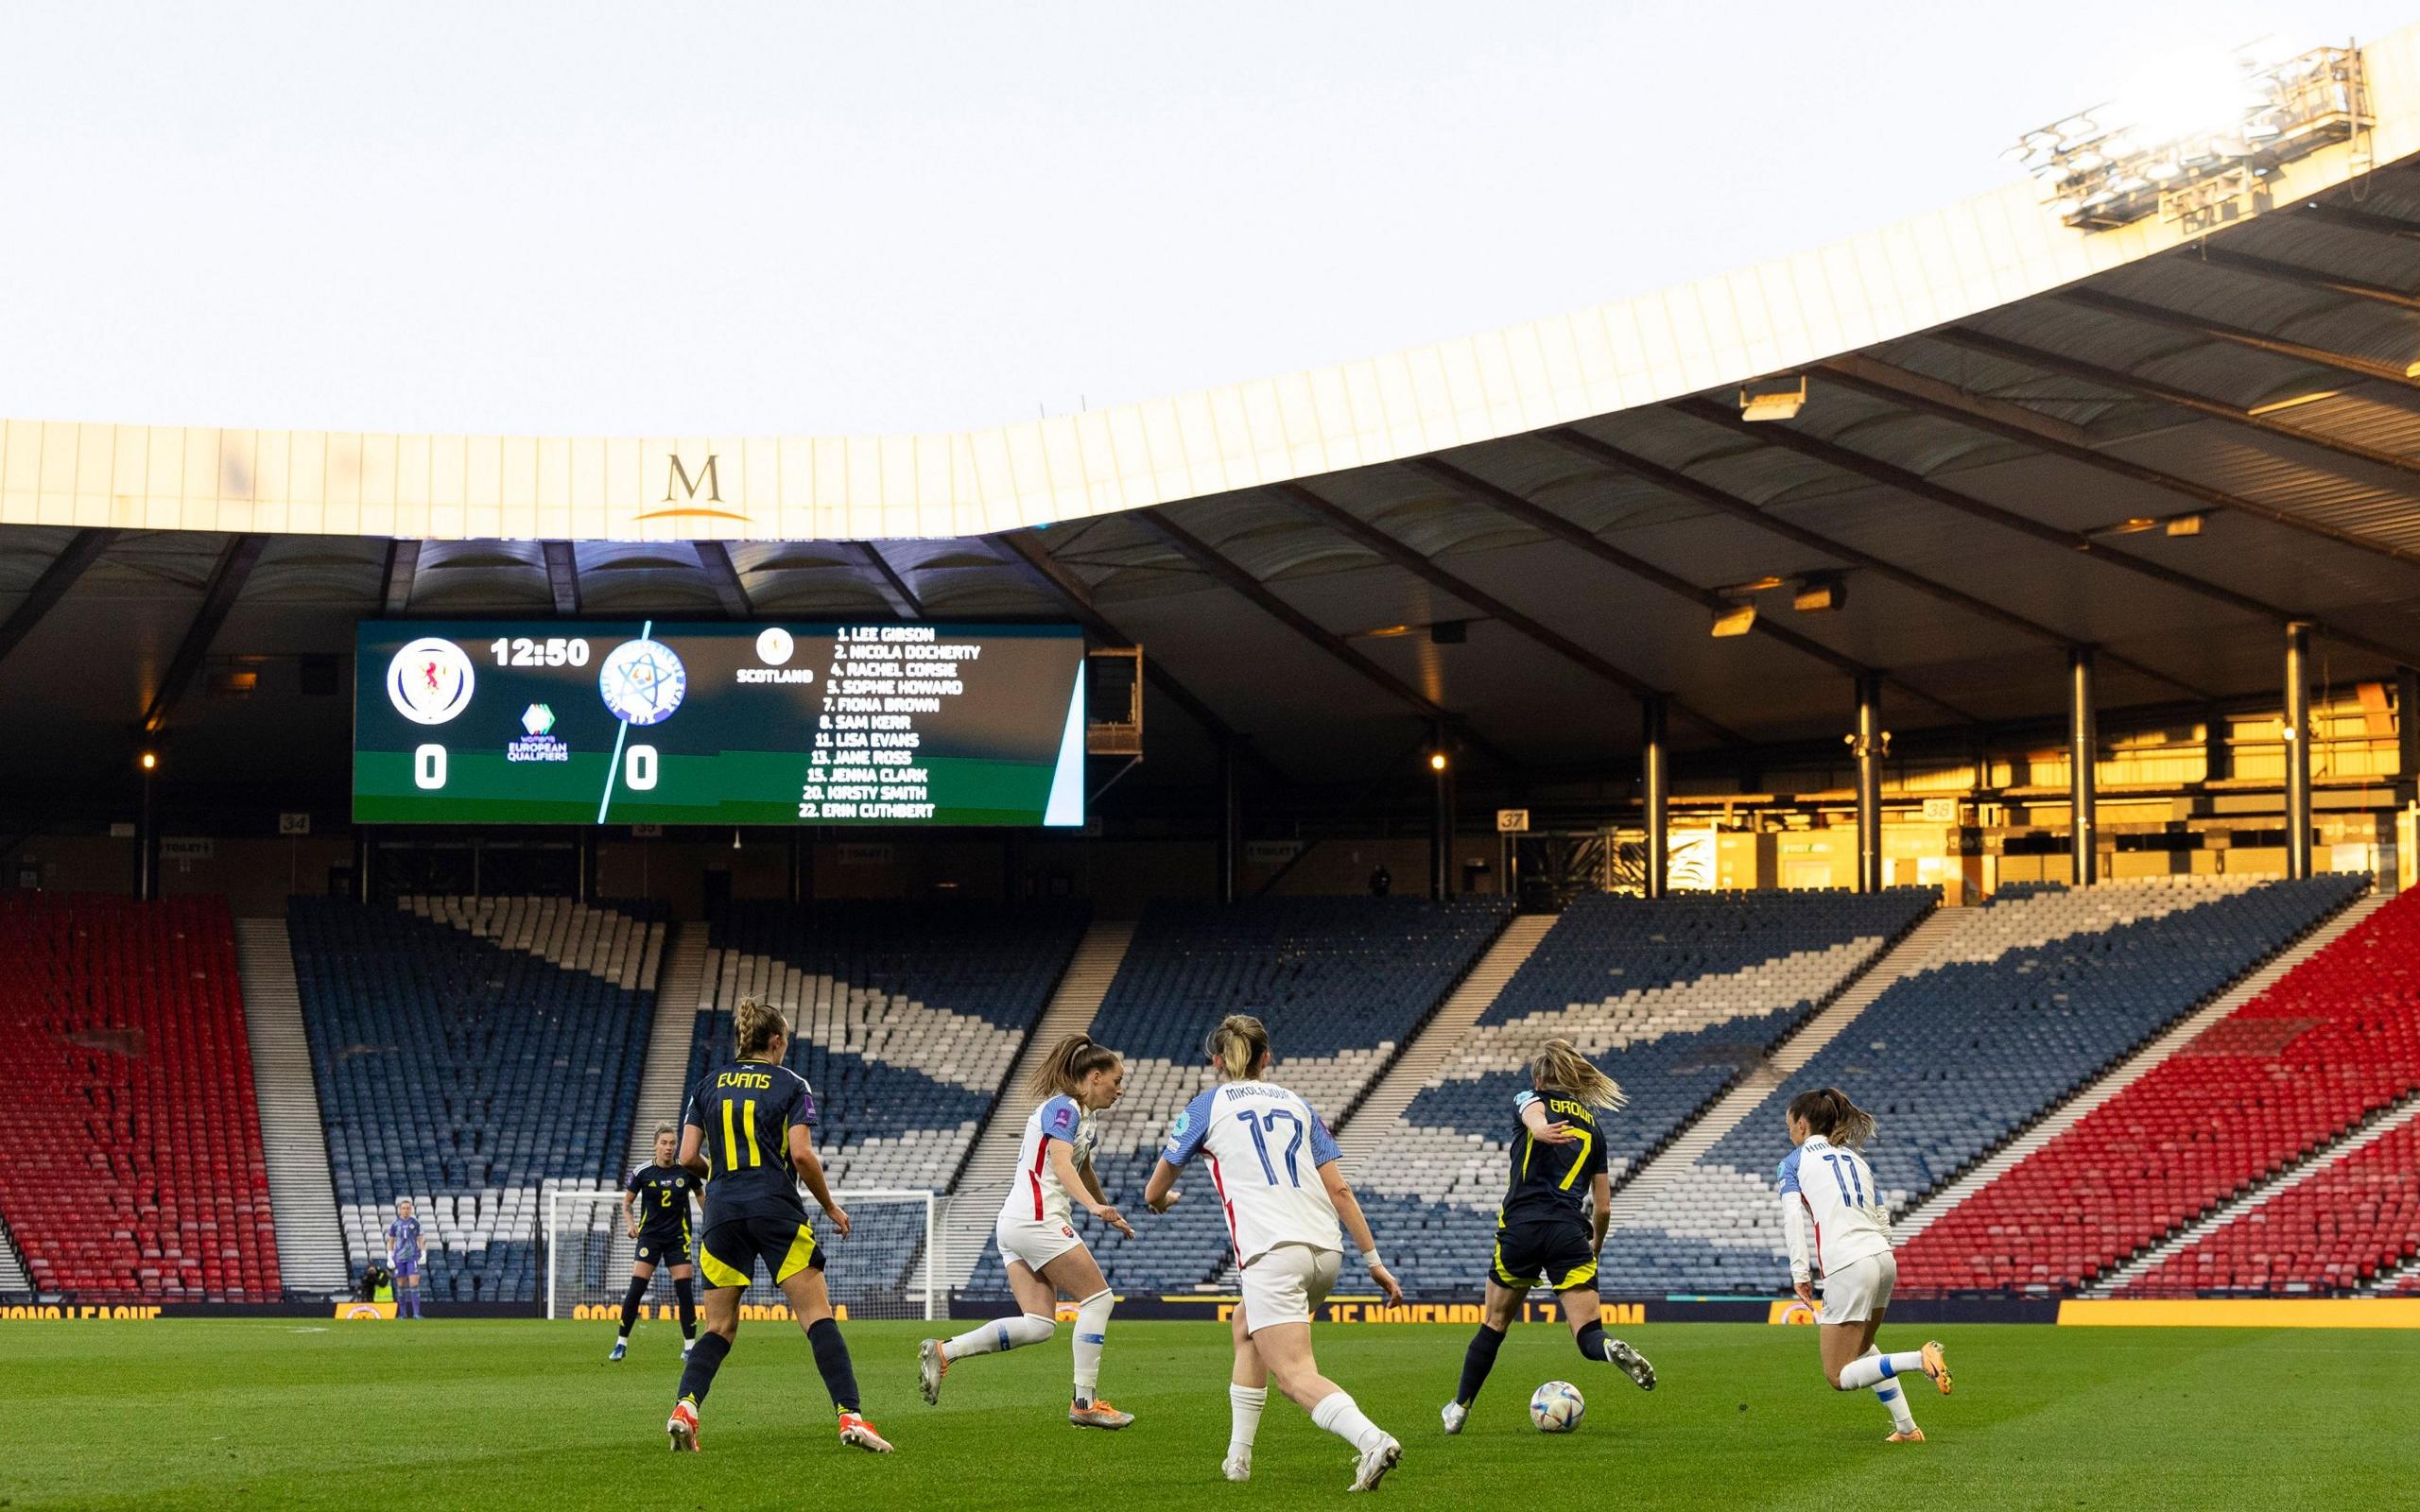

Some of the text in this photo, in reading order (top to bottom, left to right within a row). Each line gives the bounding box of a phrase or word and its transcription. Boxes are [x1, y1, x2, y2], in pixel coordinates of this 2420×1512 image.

[661, 454, 725, 503] M
[838, 627, 935, 642] 1. LEE GIBSON
[491, 638, 590, 666] 12:50
[834, 644, 981, 660] 2. NICOLA DOCHERTY
[736, 669, 813, 683] SCOTLAND
[830, 662, 958, 678] 4. RACHEL CORSIE
[827, 680, 962, 695] 5. SOPHIE HOWARD
[822, 697, 940, 712] 7. FIONA BROWN
[820, 715, 911, 730] 8. SAM KERR
[509, 742, 567, 752] EUROPEAN
[815, 732, 920, 747] 11. LISA EVANS
[507, 751, 568, 762] QUALIFIERS
[811, 750, 912, 765] 13. JANE ROSS
[415, 744, 447, 789] 0
[626, 745, 658, 790] 0
[807, 768, 927, 782] 15. JENNA CLARK
[803, 785, 926, 800] 20. KIRSTY SMITH
[799, 803, 935, 817] 22. ERIN CUTHBERT
[1927, 803, 1951, 818] 38
[283, 816, 305, 831] 34
[1502, 814, 1523, 828] 37
[717, 1072, 771, 1089] EVANS
[1550, 1099, 1595, 1126] BROWN
[722, 1098, 761, 1171] 11
[1236, 1108, 1303, 1188] 17
[1558, 1125, 1592, 1190] 7
[1823, 1155, 1863, 1208] 11
[662, 1190, 671, 1207] 2
